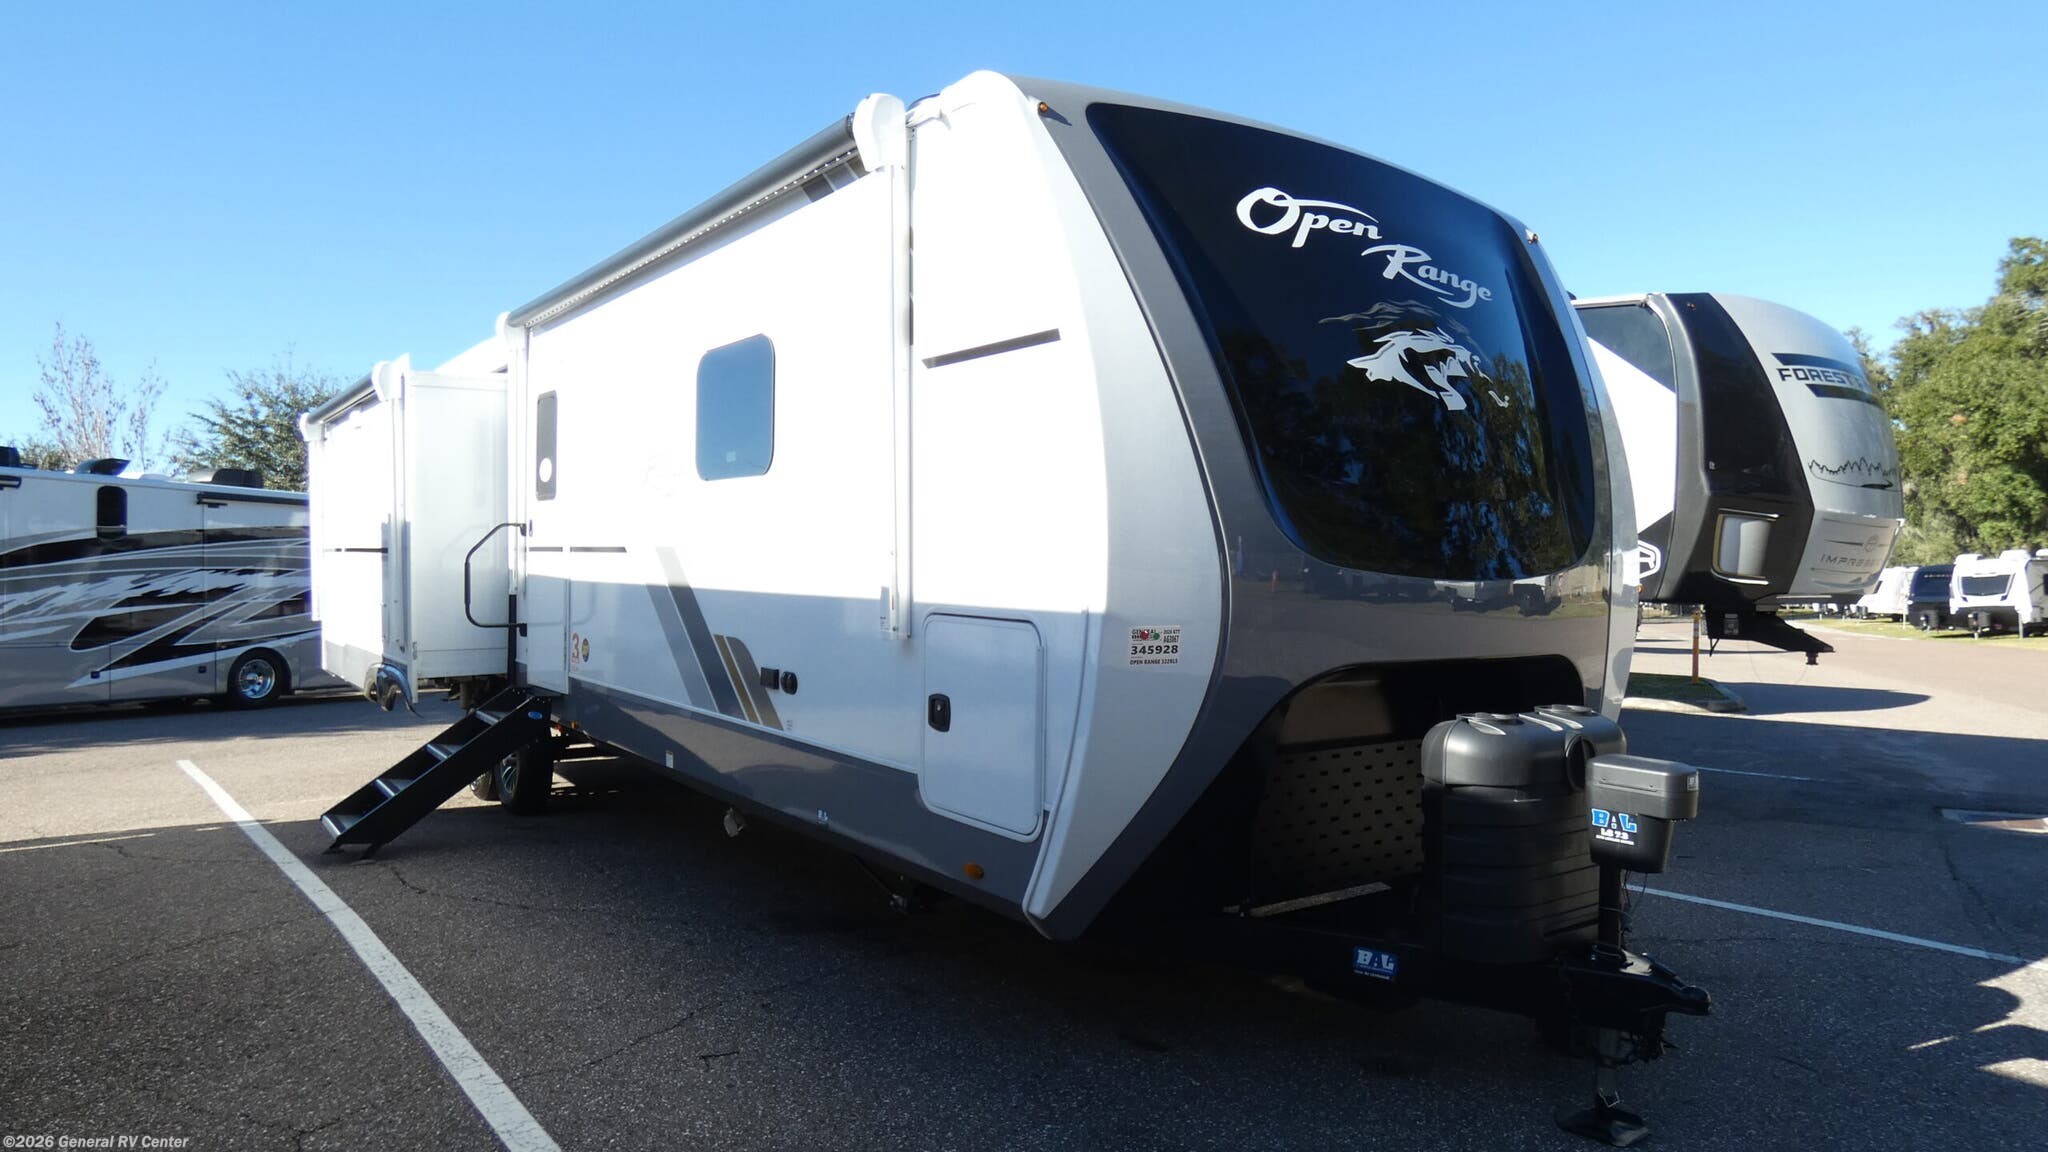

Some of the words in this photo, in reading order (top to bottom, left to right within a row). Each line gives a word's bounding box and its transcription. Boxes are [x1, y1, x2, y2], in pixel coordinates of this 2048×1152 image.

[1236, 187, 1383, 248] Open
[1361, 244, 1494, 309] Range
[1130, 645, 1179, 655] 345928
